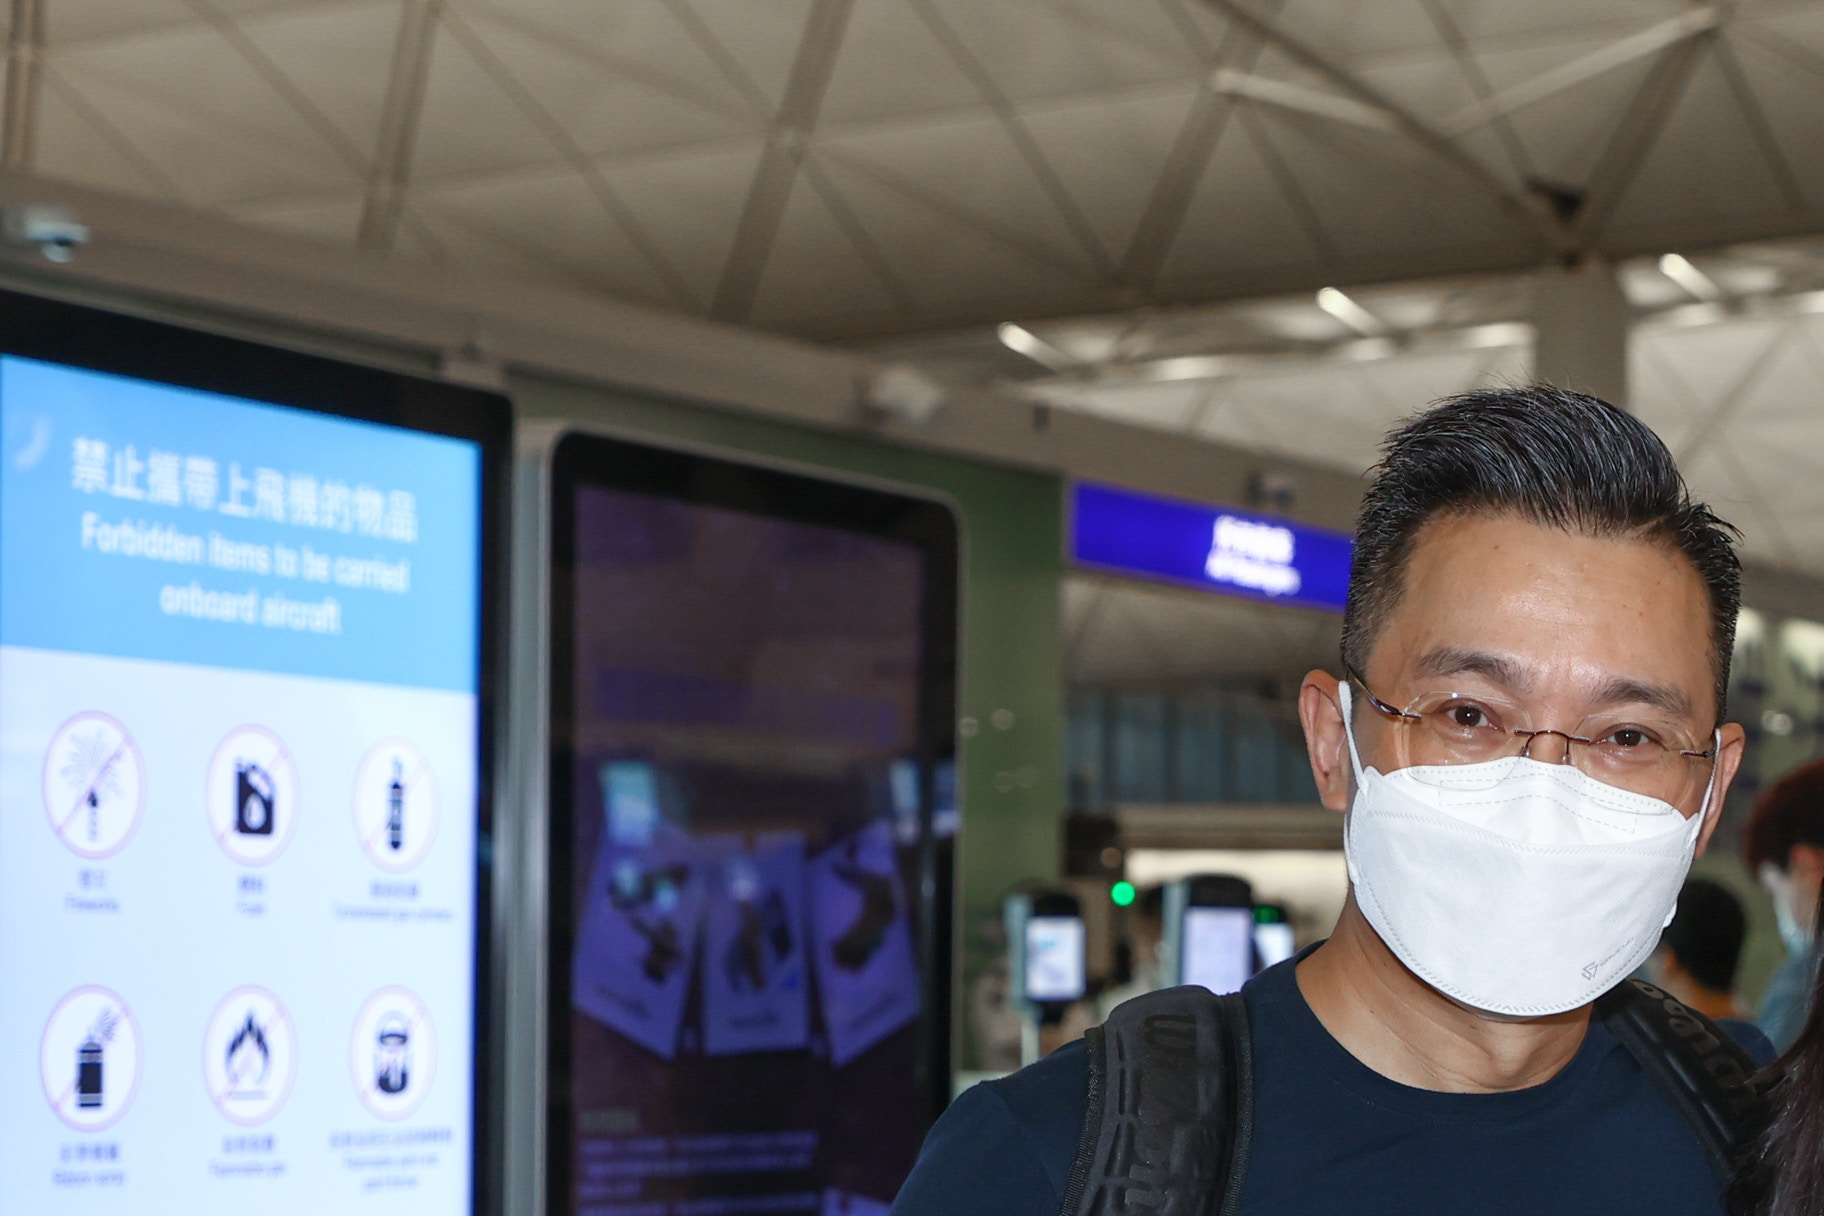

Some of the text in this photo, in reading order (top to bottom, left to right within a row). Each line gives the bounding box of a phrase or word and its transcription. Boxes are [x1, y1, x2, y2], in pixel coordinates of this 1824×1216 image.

[73, 437, 416, 543] 禁止攜帶上飛機的物品
[81, 510, 408, 594] Forbidden items to be carried
[159, 580, 343, 635] onboard aircraft
[1631, 979, 1758, 1118] Wilso
